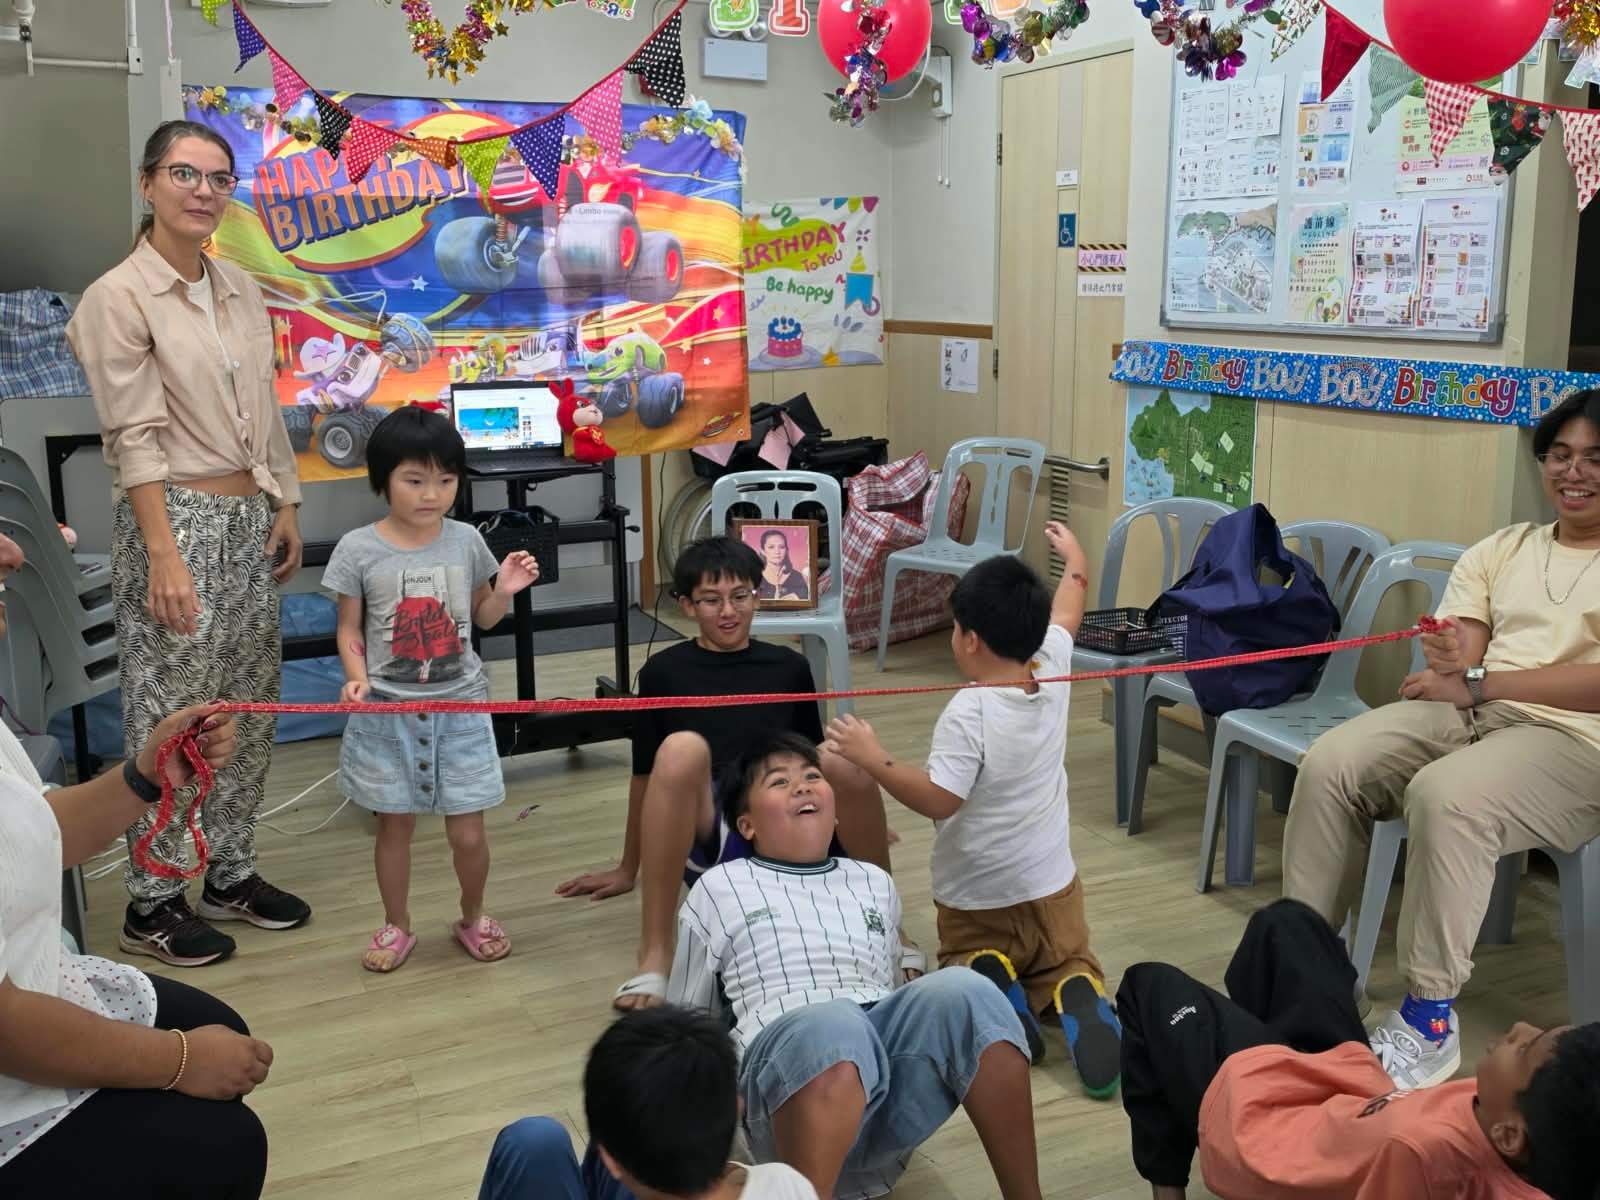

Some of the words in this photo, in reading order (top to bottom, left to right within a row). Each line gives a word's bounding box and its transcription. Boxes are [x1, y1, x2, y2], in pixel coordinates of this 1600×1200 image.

[257, 148, 388, 206] HAP
[743, 221, 847, 270] IRTHDAY
[766, 276, 784, 292] Be
[787, 278, 834, 305] happy
[1162, 348, 1248, 391] Birthday
[1253, 356, 1311, 395] Boy
[1319, 363, 1389, 408] Boy
[1392, 366, 1519, 417] Birthday
